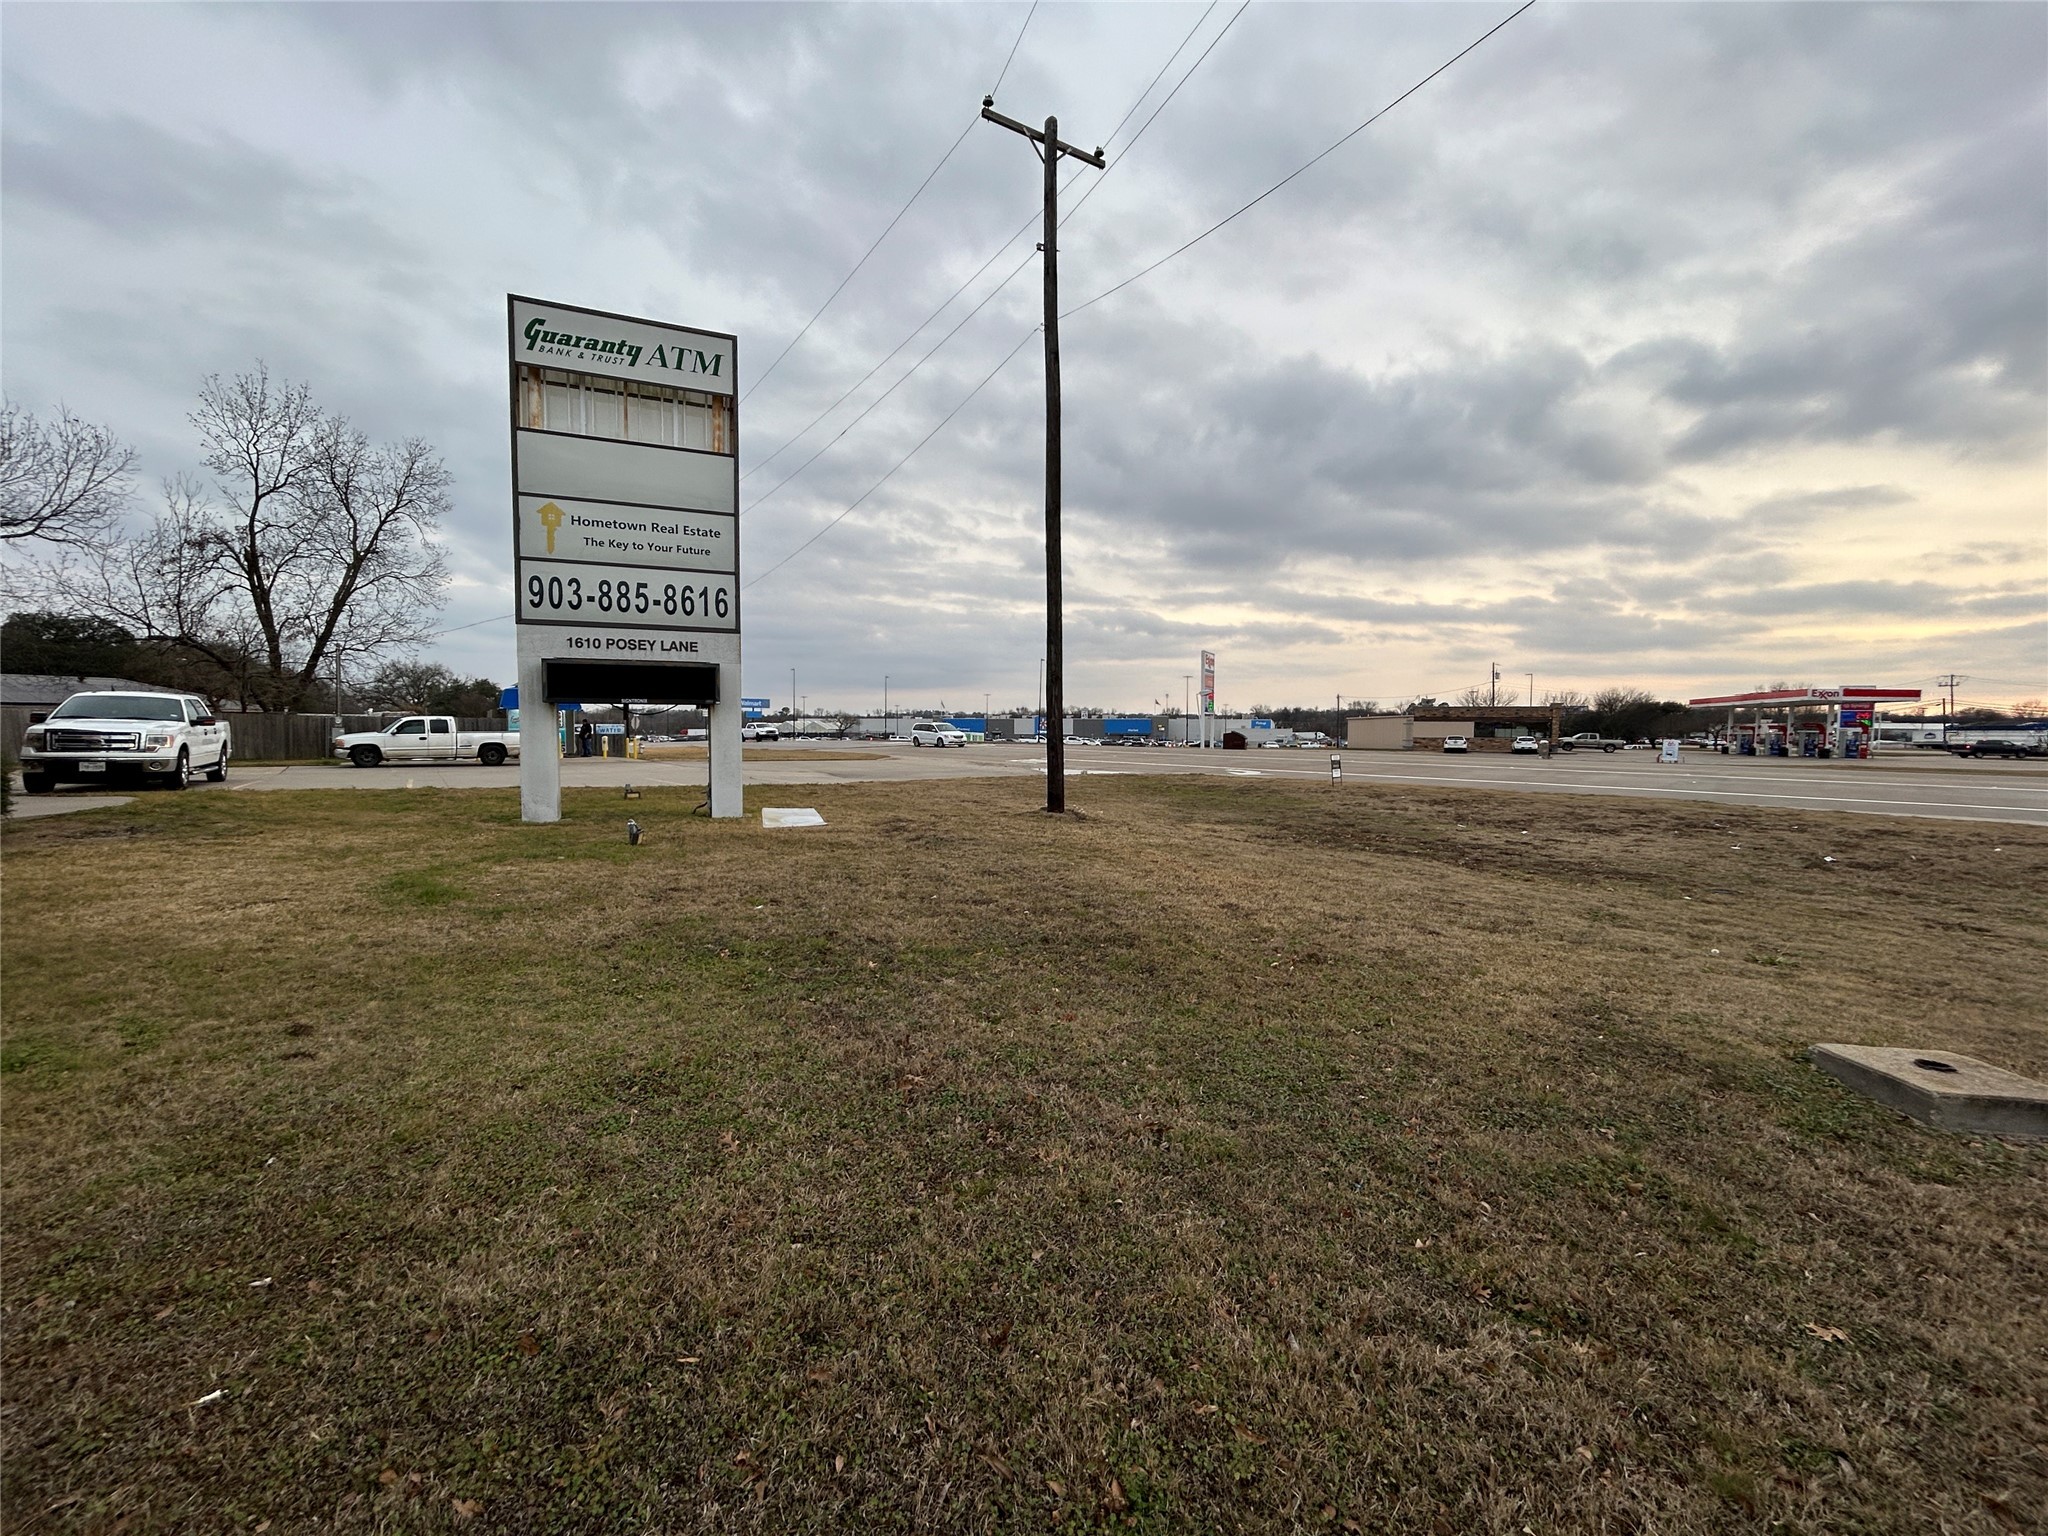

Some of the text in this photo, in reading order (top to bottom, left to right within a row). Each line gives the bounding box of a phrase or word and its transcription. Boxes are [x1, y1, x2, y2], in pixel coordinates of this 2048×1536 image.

[523, 318, 643, 367] Guaranty
[538, 345, 625, 366] BANK & TRUST
[645, 344, 725, 377] ATM
[571, 515, 721, 538] Hometown Real Estate
[583, 537, 711, 556] The Key to Your Future
[528, 575, 729, 618] 903-885-8616
[566, 637, 699, 652] 1610 POSEY LANE
[1811, 689, 1839, 699] Exxon
